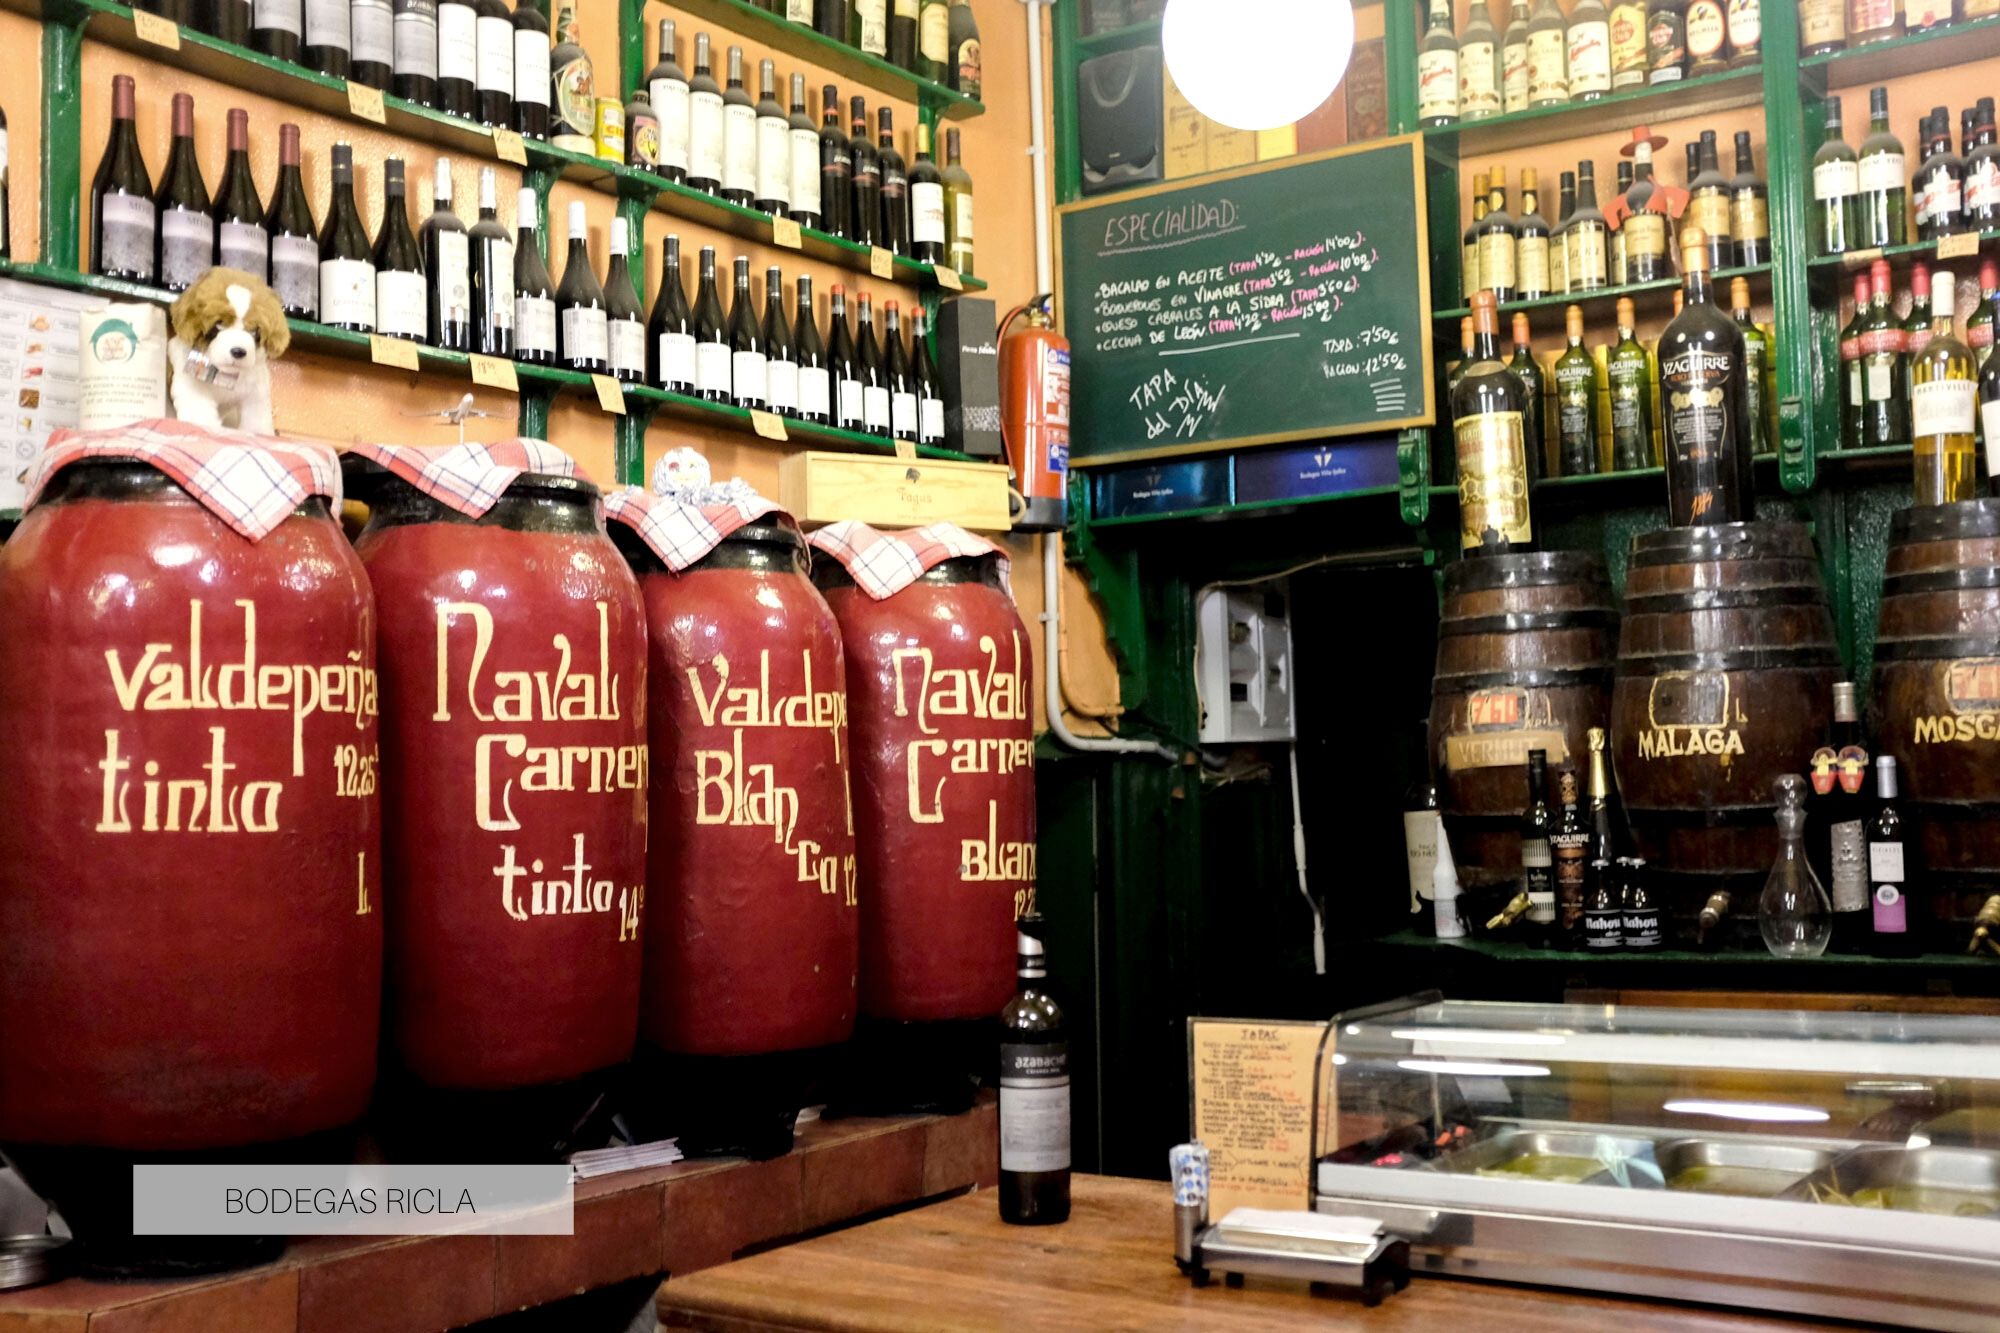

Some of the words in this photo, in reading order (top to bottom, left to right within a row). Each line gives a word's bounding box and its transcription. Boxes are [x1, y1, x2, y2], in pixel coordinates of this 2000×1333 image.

[1156, 275, 1170, 289] EN
[1102, 317, 1138, 333] QUESO
[1147, 307, 1204, 326] CABRALES
[1209, 305, 1219, 319] A
[1226, 301, 1241, 315] LA
[1171, 295, 1187, 307] EN
[1103, 334, 1143, 351] CECINA
[1149, 330, 1165, 344] DE
[1663, 356, 1730, 379] YZAGUIRRE
[1129, 367, 1177, 410] TAPA
[1144, 411, 1171, 439] del
[433, 601, 620, 722] Naval
[892, 629, 1027, 734] Naval
[1638, 728, 1745, 761] MALAGA
[96, 726, 283, 832] tinto
[493, 833, 613, 921] tinto
